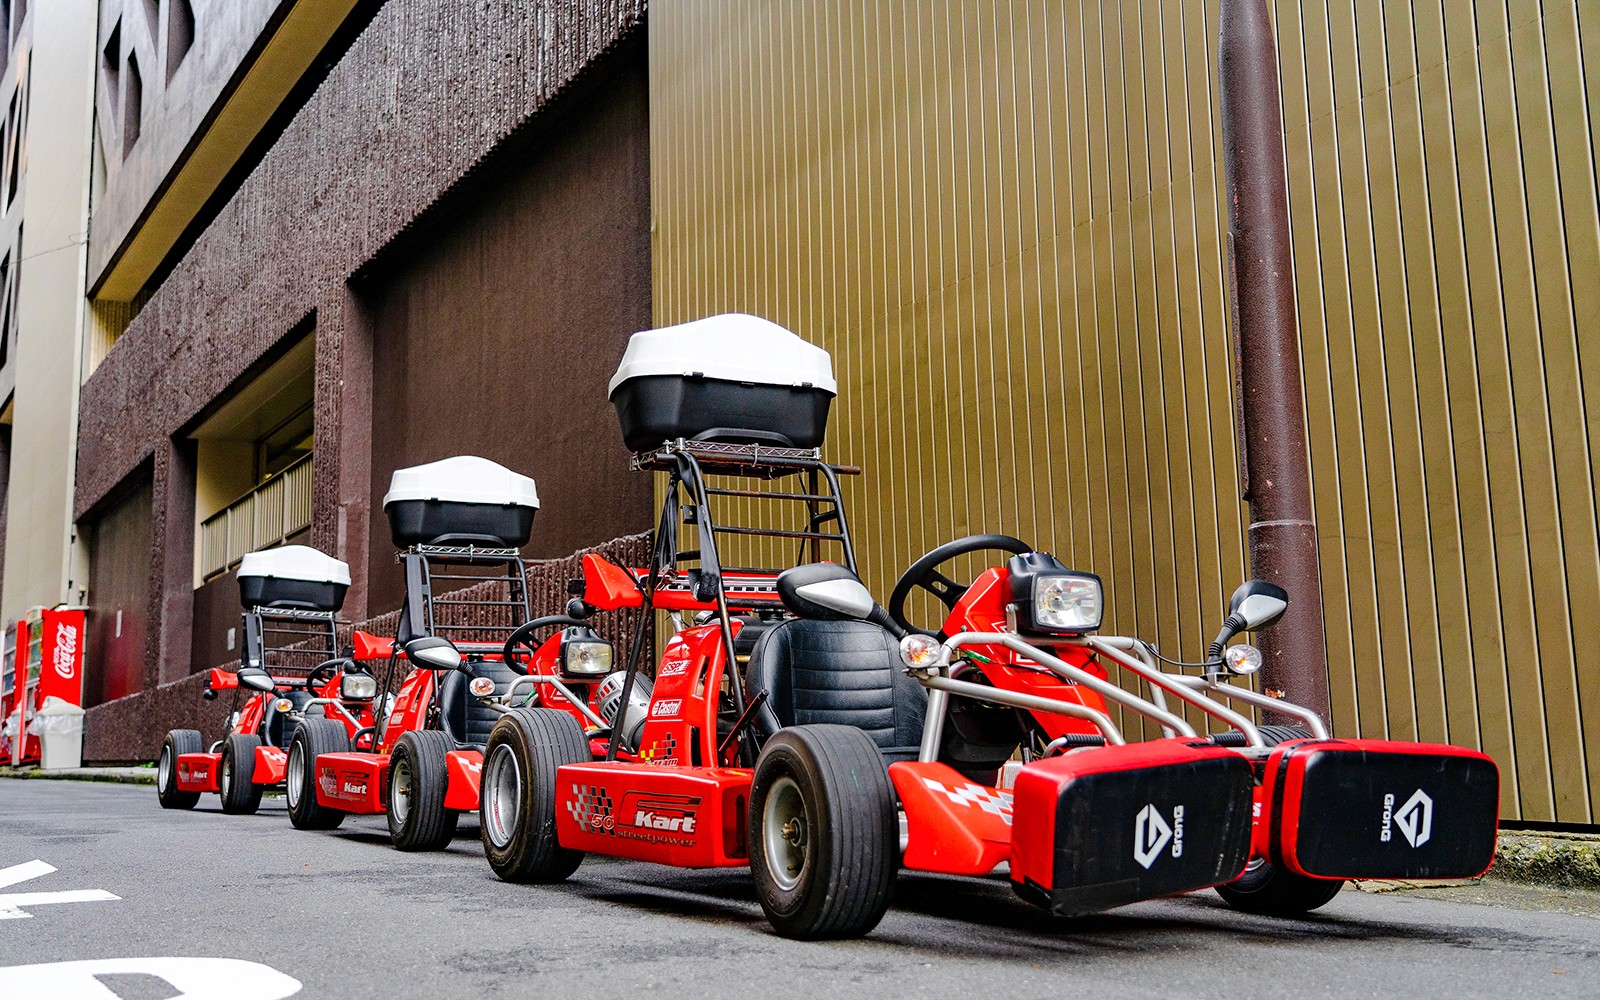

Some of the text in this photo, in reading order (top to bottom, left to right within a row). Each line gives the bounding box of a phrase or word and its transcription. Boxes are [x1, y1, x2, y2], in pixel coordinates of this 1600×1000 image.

[344, 782, 368, 795] Kart
[591, 813, 615, 830] 50
[634, 810, 697, 833] Kart
[617, 830, 697, 847] streetpower
